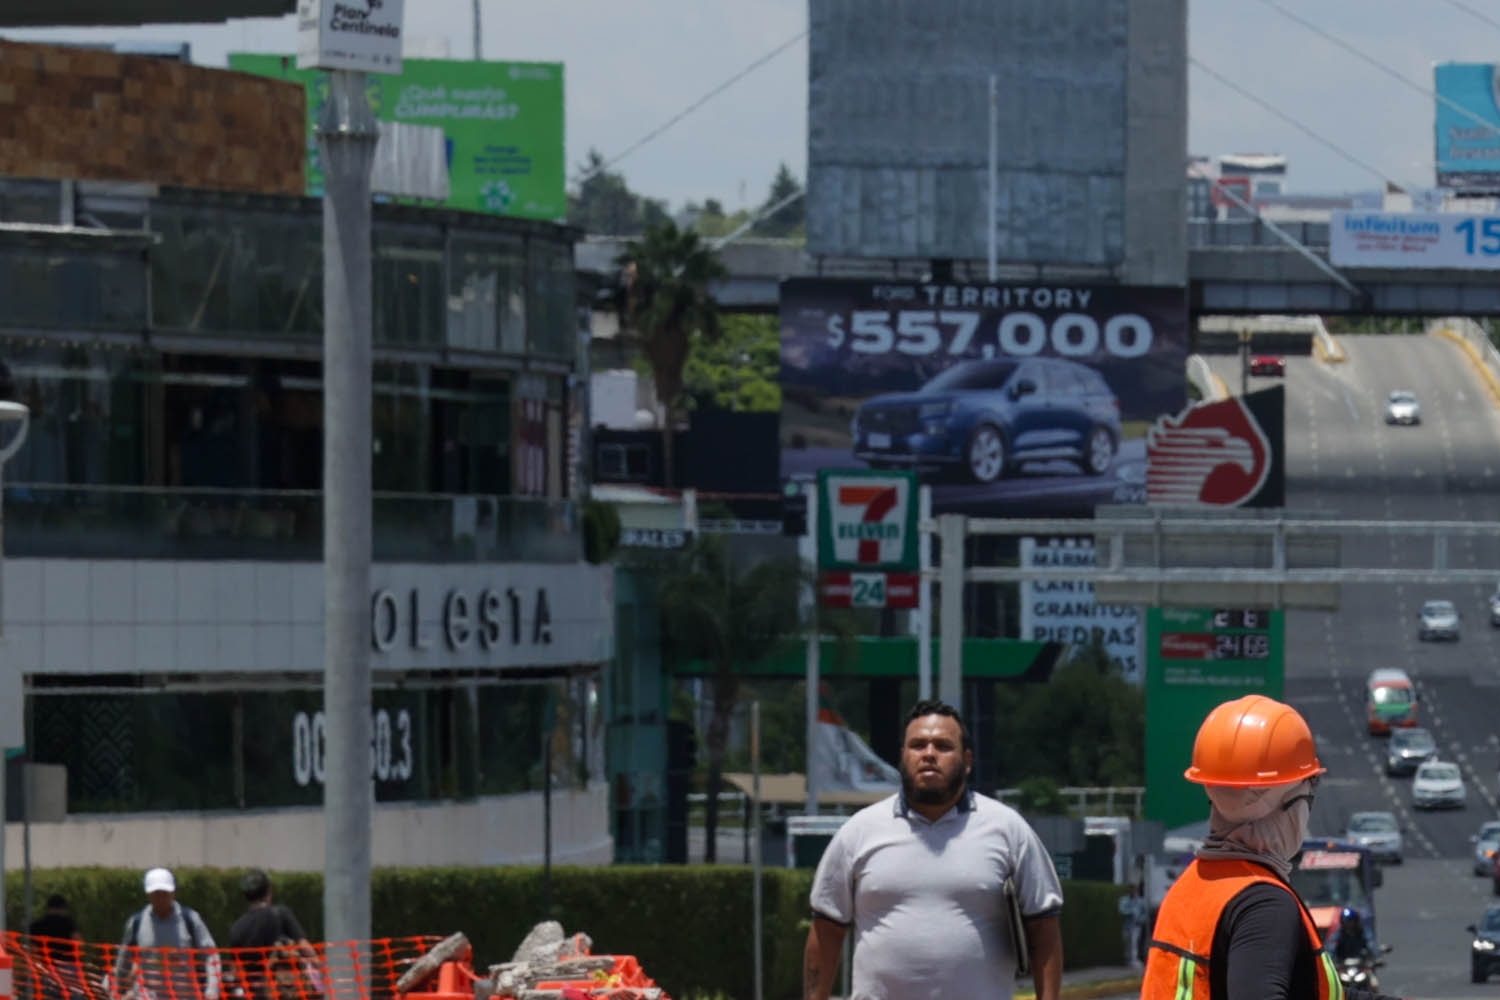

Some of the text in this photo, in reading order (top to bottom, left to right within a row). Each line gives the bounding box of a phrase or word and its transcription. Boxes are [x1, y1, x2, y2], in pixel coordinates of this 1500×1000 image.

[330, 17, 399, 38] Centinela
[923, 286, 1093, 309] TERRITORY
[827, 311, 1153, 360] $557,000
[837, 485, 898, 564] 7
[852, 578, 885, 603] 24
